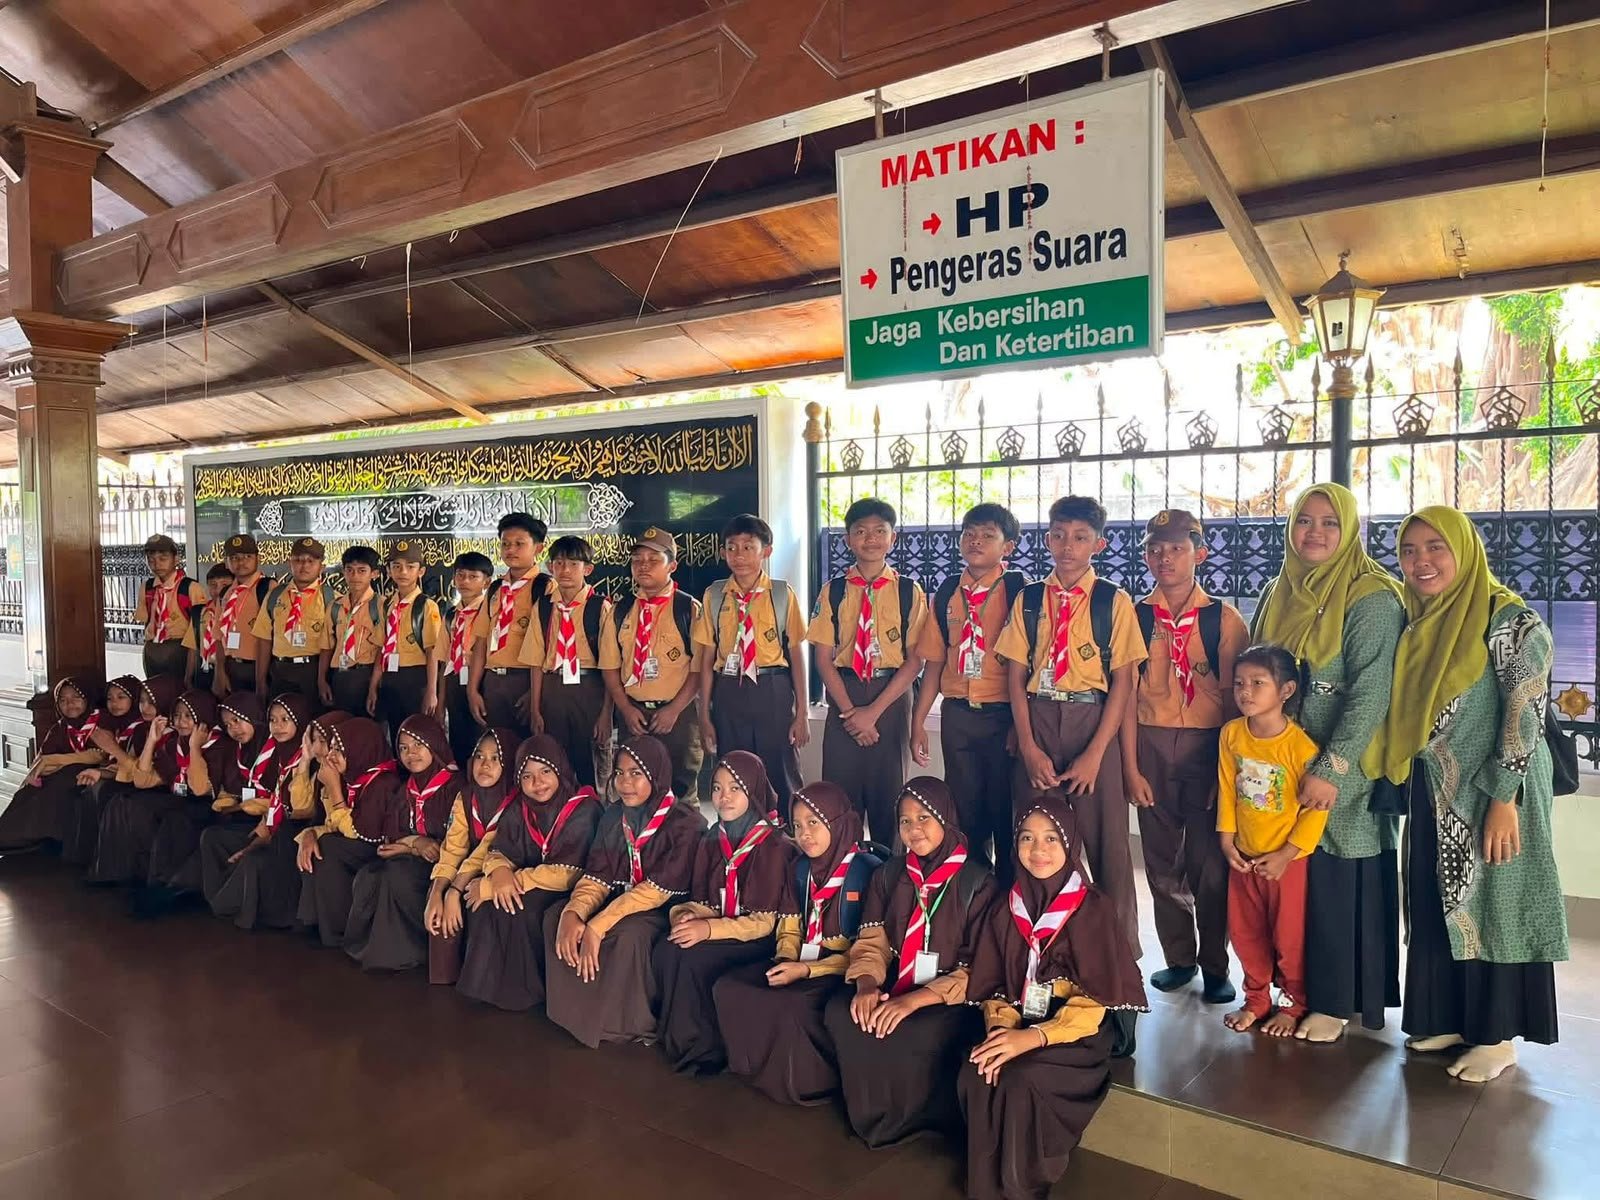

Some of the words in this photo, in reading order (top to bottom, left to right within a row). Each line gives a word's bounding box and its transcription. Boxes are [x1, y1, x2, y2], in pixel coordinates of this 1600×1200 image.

[881, 119, 1056, 188] MATIKAN
[1074, 120, 1085, 145] :
[956, 182, 1050, 238] HP
[890, 246, 1022, 297] Pengeras
[1033, 227, 1127, 272] Suara
[865, 320, 922, 346] Jaga
[937, 296, 1085, 335] Kebersihan
[940, 341, 987, 364] Dan
[995, 322, 1135, 357] Ketertiban
